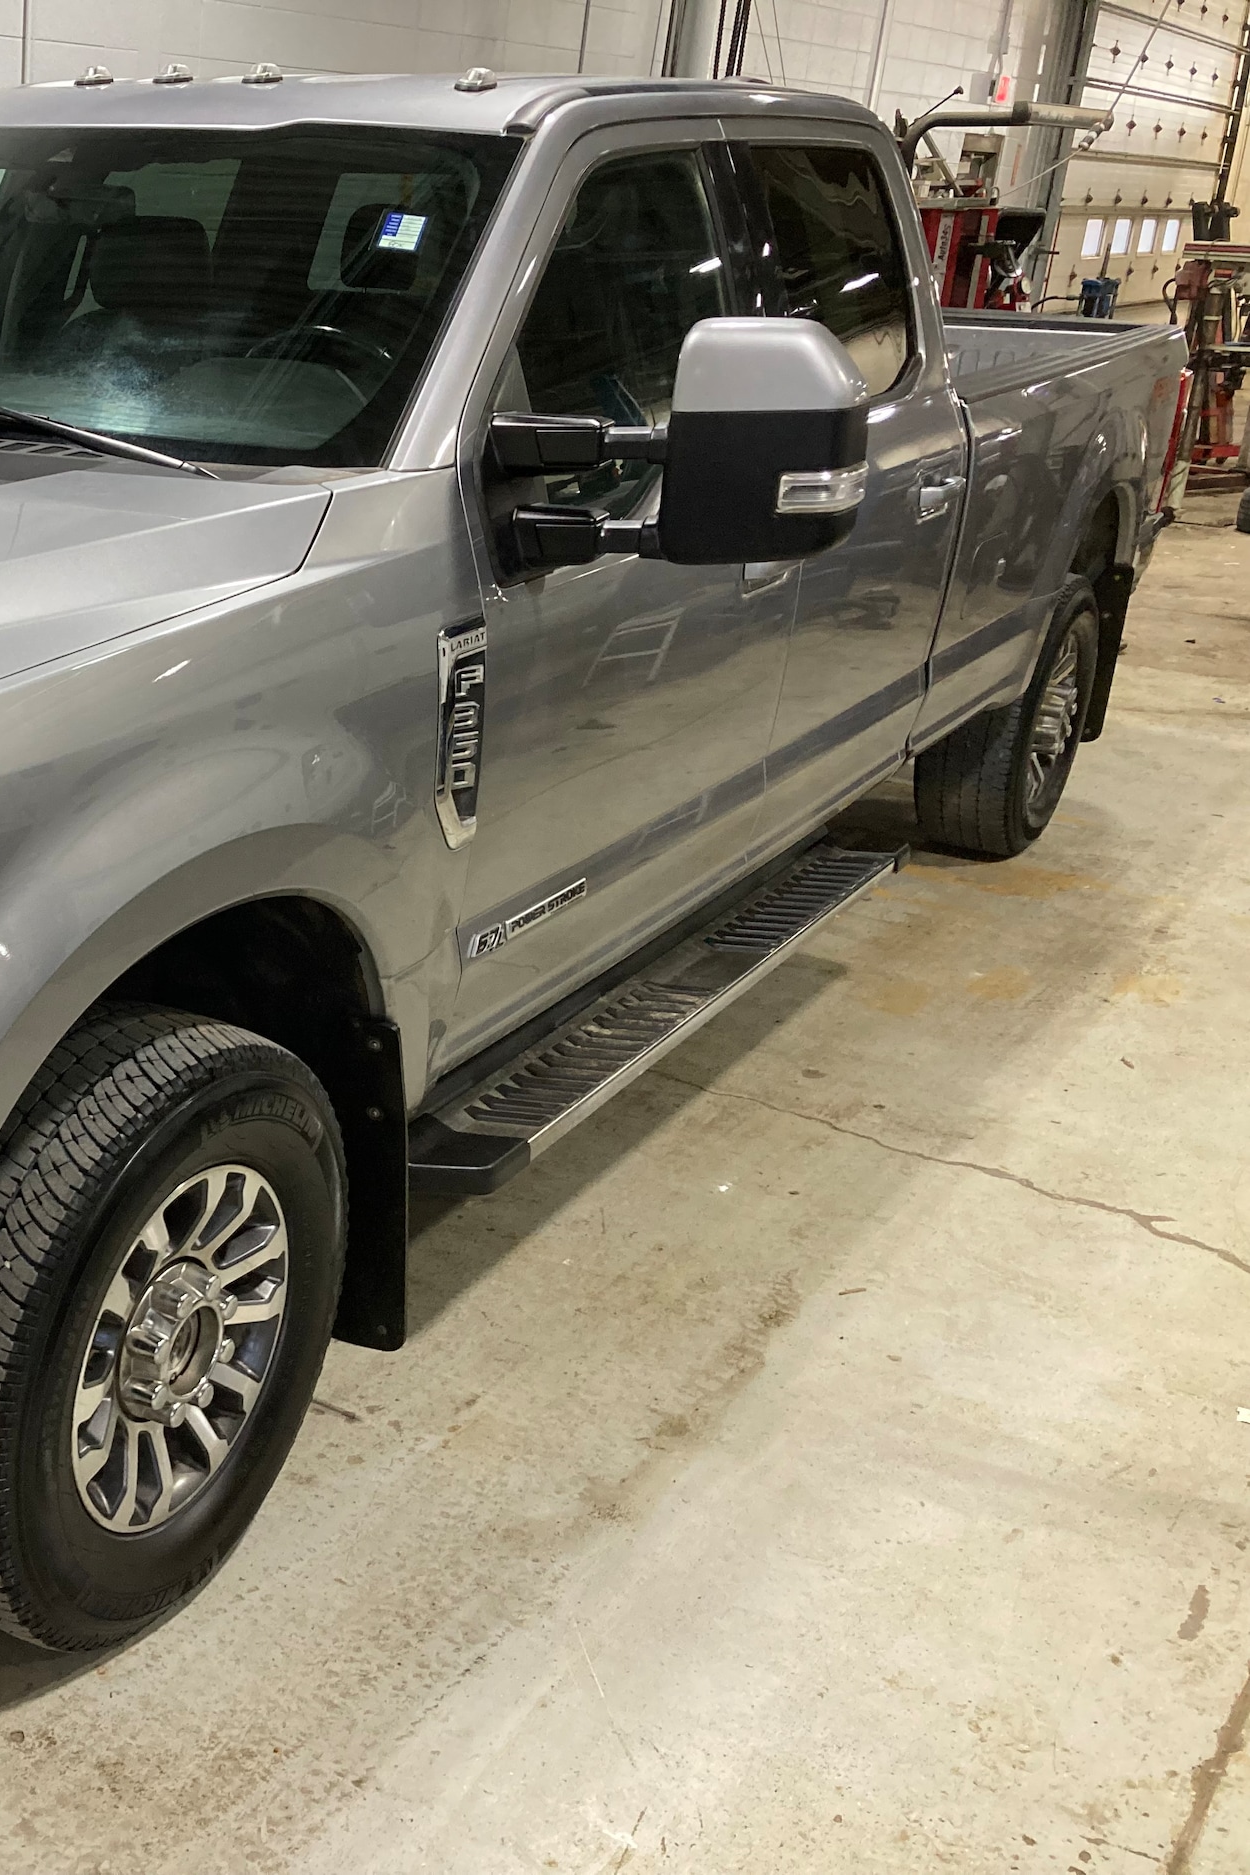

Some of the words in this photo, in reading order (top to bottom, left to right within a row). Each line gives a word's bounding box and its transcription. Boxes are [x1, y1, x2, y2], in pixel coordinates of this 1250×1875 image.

[451, 631, 486, 650] LARIAT
[510, 905, 547, 933] POWER
[547, 881, 586, 912] STROKE
